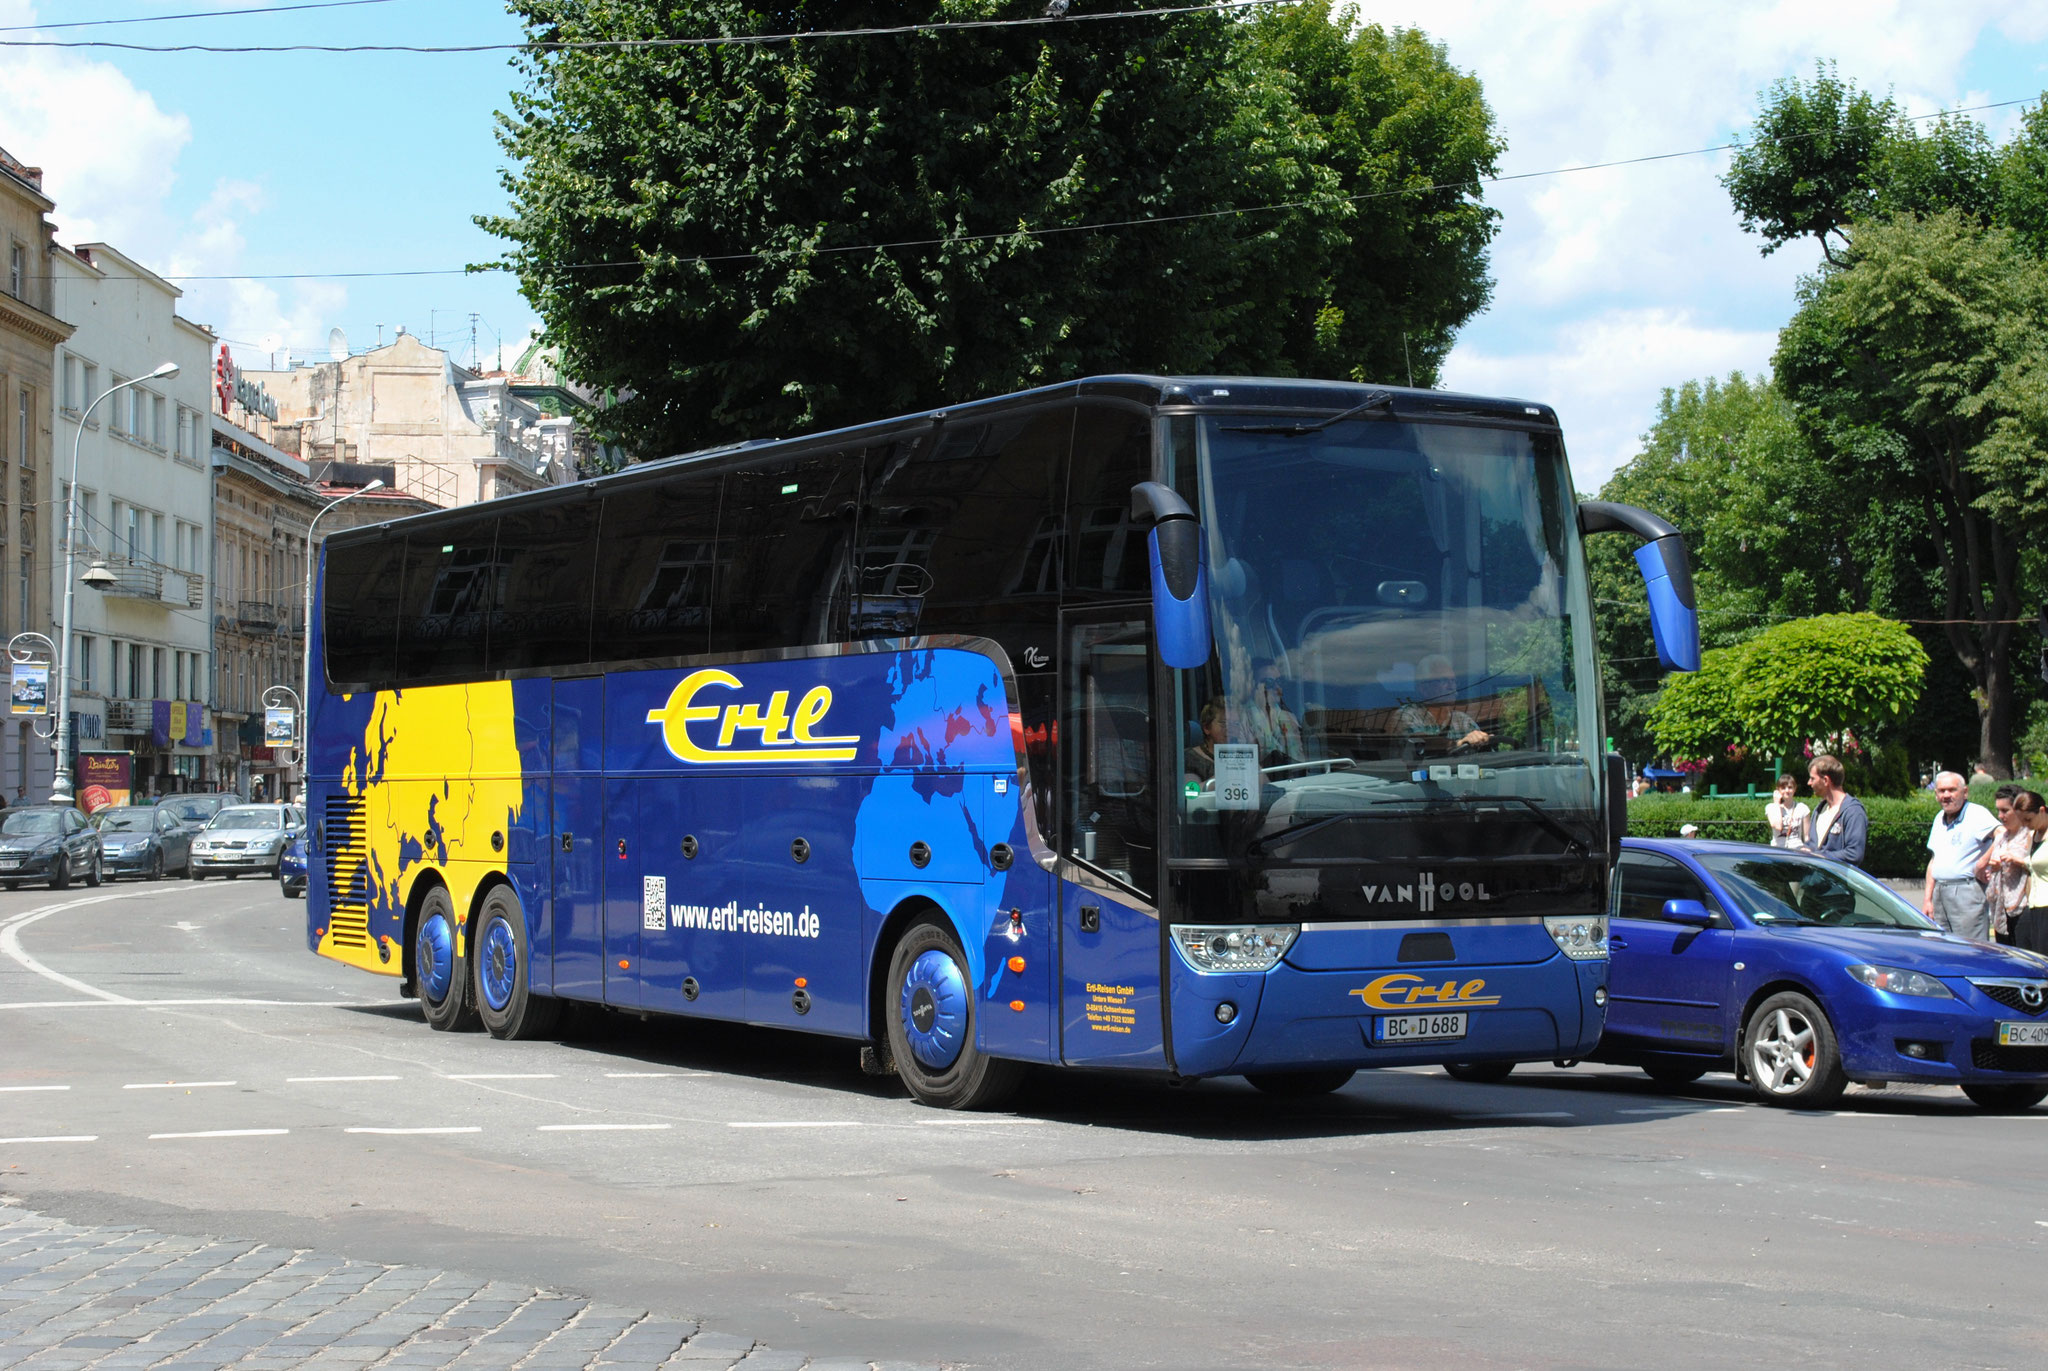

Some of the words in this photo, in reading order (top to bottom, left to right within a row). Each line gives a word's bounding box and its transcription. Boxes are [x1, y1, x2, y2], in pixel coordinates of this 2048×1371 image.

[645, 668, 861, 764] Ertl
[1224, 788, 1249, 801] 396
[670, 900, 820, 938] www.ertl-reisen.de
[1086, 983, 1116, 993] Ertl-Reisen
[1117, 985, 1134, 995] GmbH
[1348, 973, 1502, 1010] Ertl
[1389, 1019, 1408, 1036] BC
[1418, 1018, 1428, 1035] D
[1431, 1016, 1459, 1034] 688
[2010, 1027, 2028, 1042] BC
